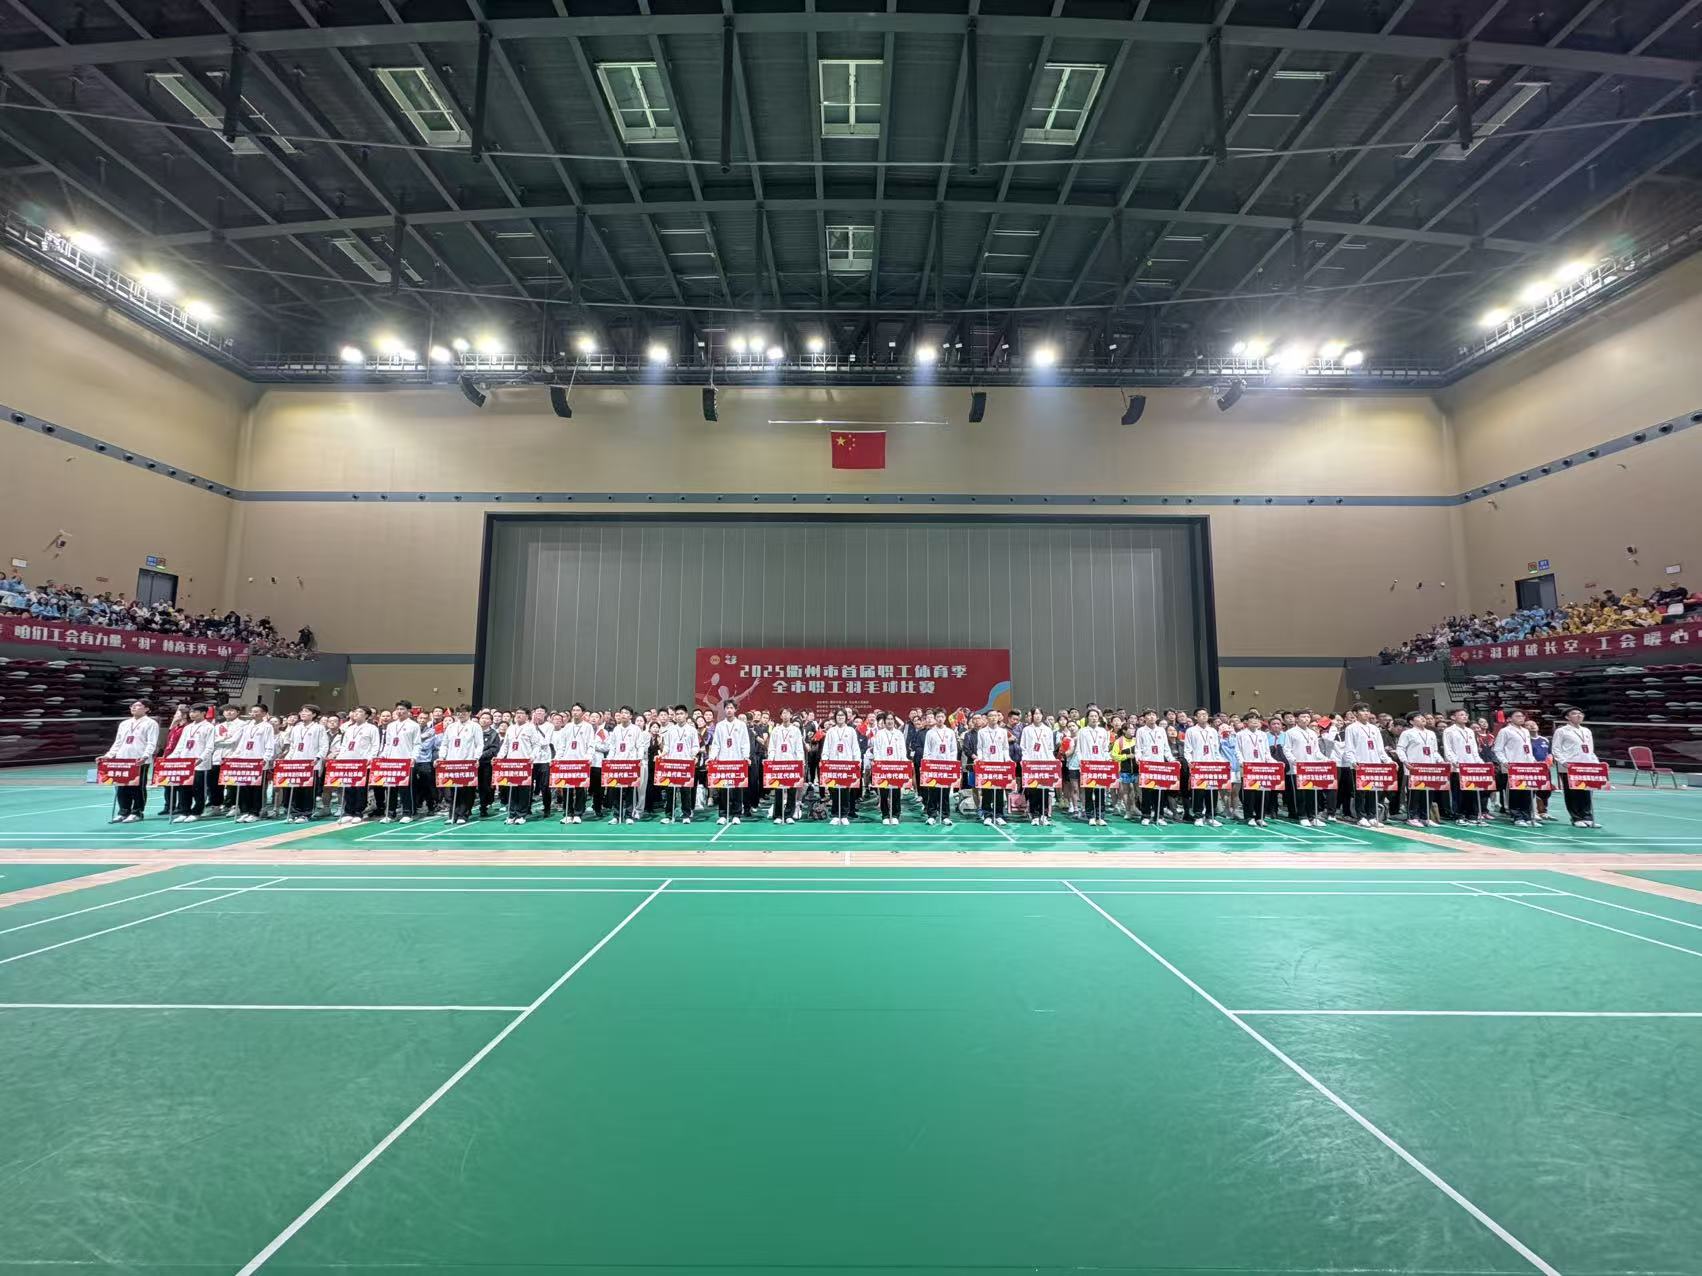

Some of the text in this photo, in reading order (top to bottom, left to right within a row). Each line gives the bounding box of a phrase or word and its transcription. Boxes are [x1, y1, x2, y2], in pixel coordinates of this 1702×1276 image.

[740, 664, 967, 678] 2025衢州市首届职工体育季
[772, 680, 935, 694] 全市职工羽毛球比赛
